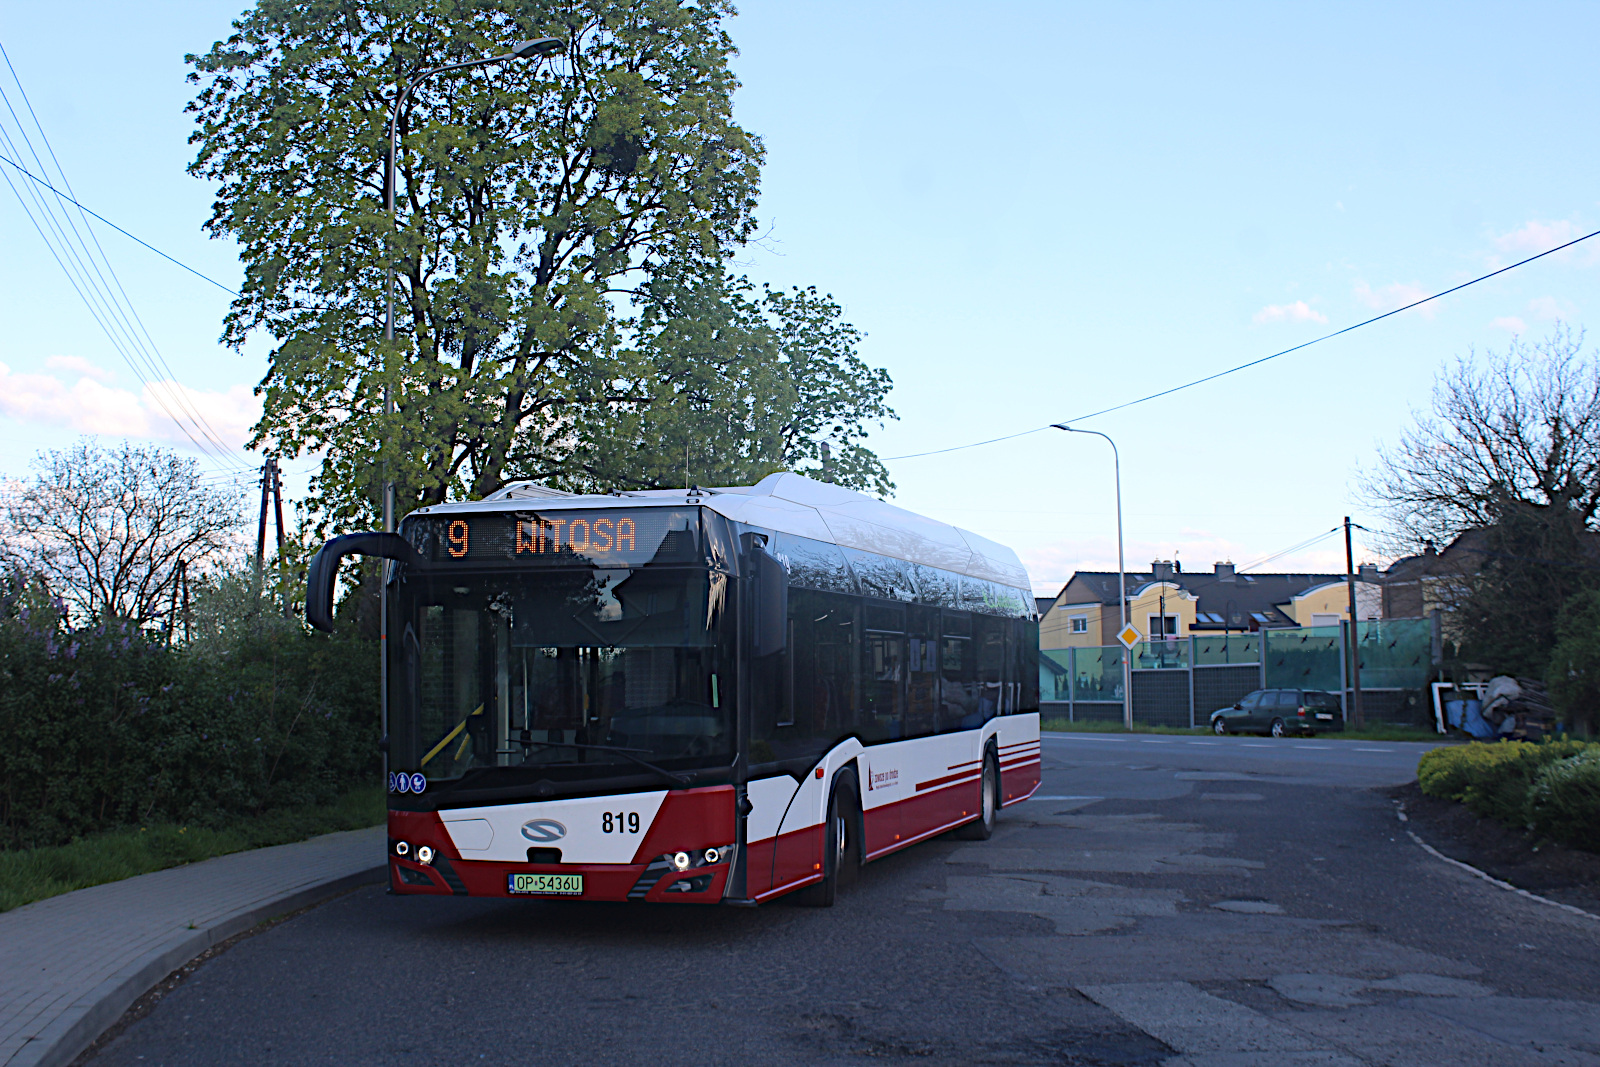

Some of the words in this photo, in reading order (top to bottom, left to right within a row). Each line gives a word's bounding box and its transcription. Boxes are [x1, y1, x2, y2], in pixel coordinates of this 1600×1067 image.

[448, 520, 469, 557] 9
[516, 518, 636, 553] WITOSA
[602, 812, 640, 833] 819
[517, 876, 534, 890] OP
[538, 876, 580, 890] 5436U
